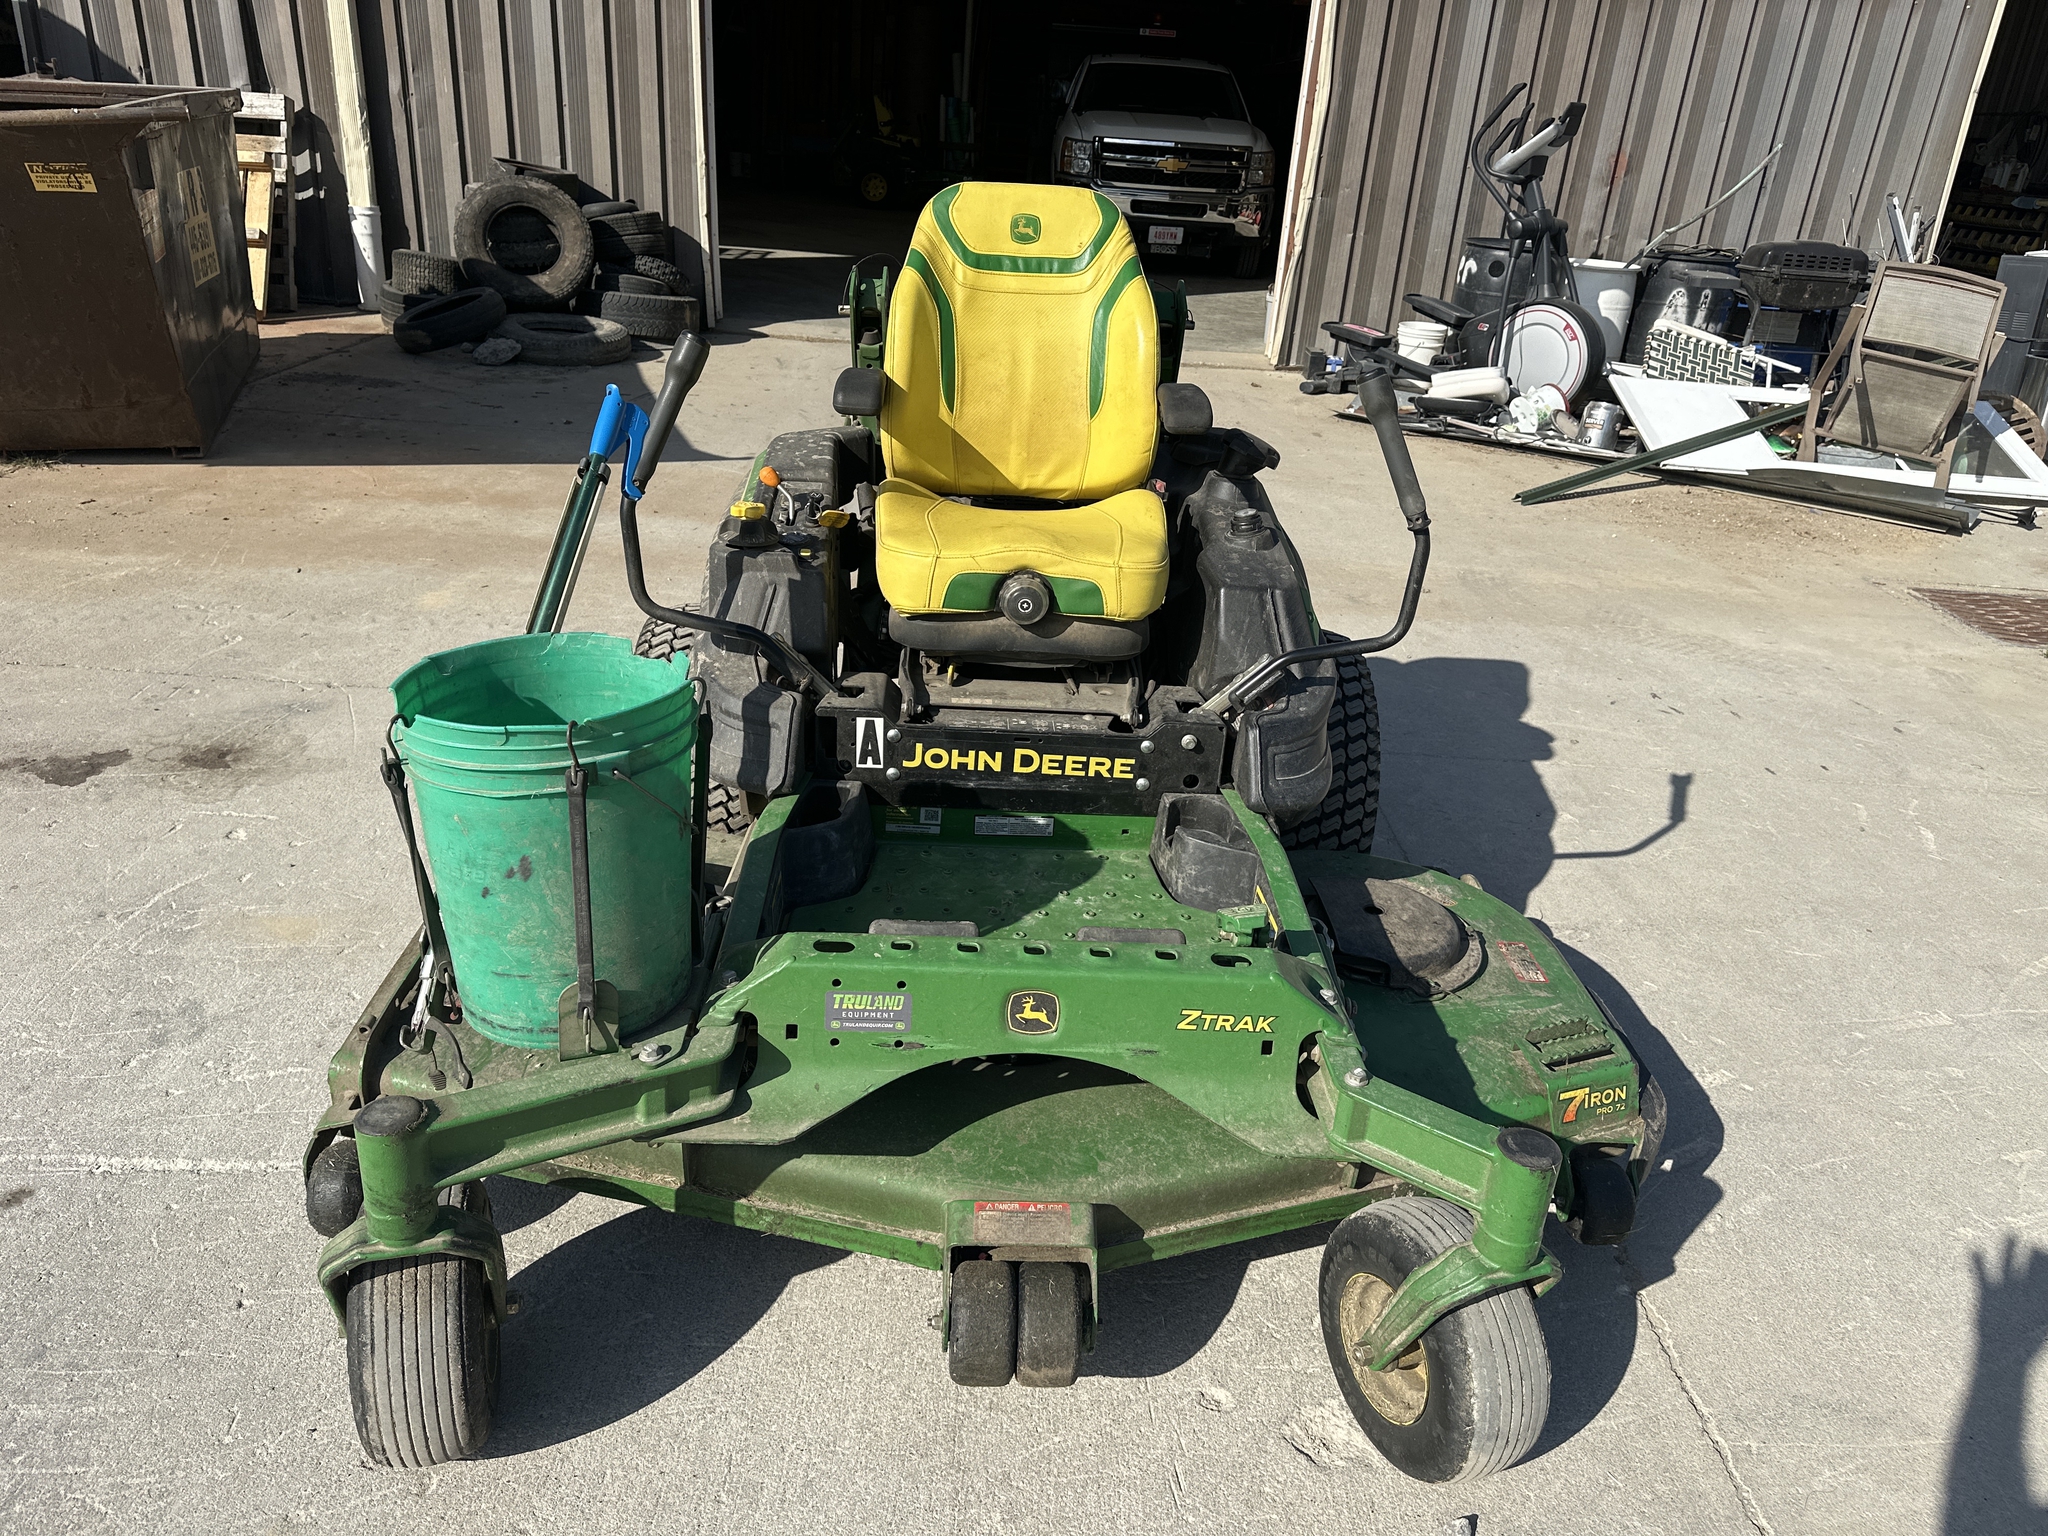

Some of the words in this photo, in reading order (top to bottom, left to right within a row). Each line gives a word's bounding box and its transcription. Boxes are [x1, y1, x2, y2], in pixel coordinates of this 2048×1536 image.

[858, 719, 882, 766] A
[902, 743, 1002, 772] JOHN
[1013, 748, 1136, 779] DEERE
[833, 994, 905, 1011] TRULAND
[842, 1011, 895, 1019] EQUIPMENT
[1176, 1009, 1279, 1033] ZTRAK
[1596, 1105, 1614, 1116] PRO
[1616, 1103, 1626, 1111] 72
[994, 1203, 1020, 1211] DANGER
